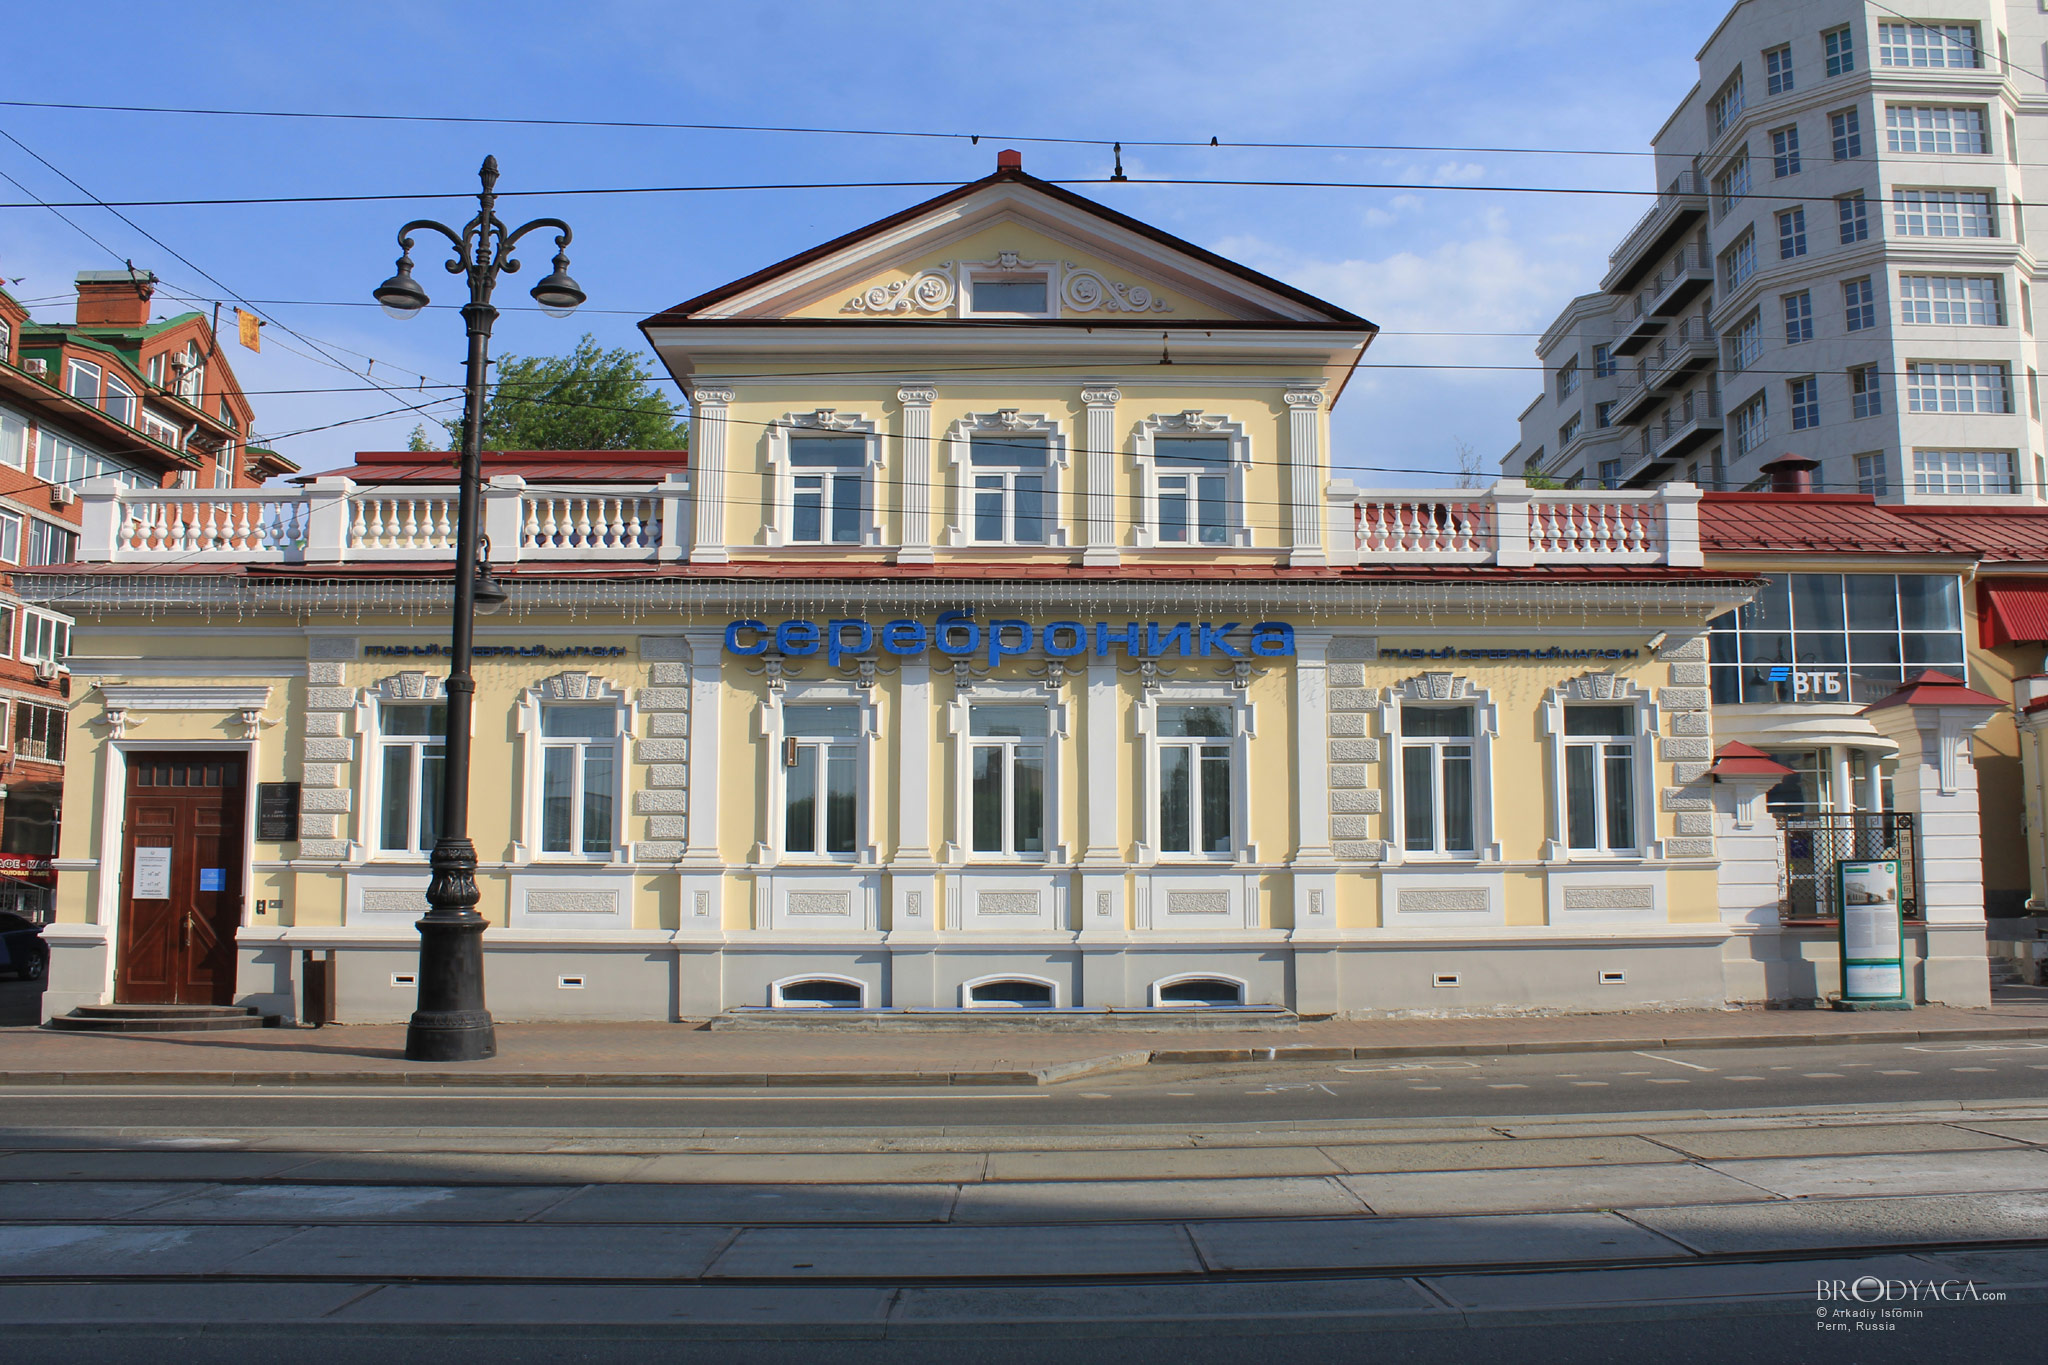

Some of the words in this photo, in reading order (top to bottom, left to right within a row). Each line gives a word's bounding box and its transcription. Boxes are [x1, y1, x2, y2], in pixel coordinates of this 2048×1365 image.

[723, 608, 1296, 667] сереброника
[364, 643, 439, 656] ГЛАВНЫЙ
[441, 644, 546, 656] СЕБРЯНЫЙ
[548, 646, 626, 658] МАГАЗИН
[1379, 646, 1456, 659] ГЛАВНЫЙ
[1458, 646, 1561, 659] СЕРЕБРЯНЫЙ
[1562, 648, 1639, 659] МАГАЗИН
[1793, 671, 1842, 695] ВТБ
